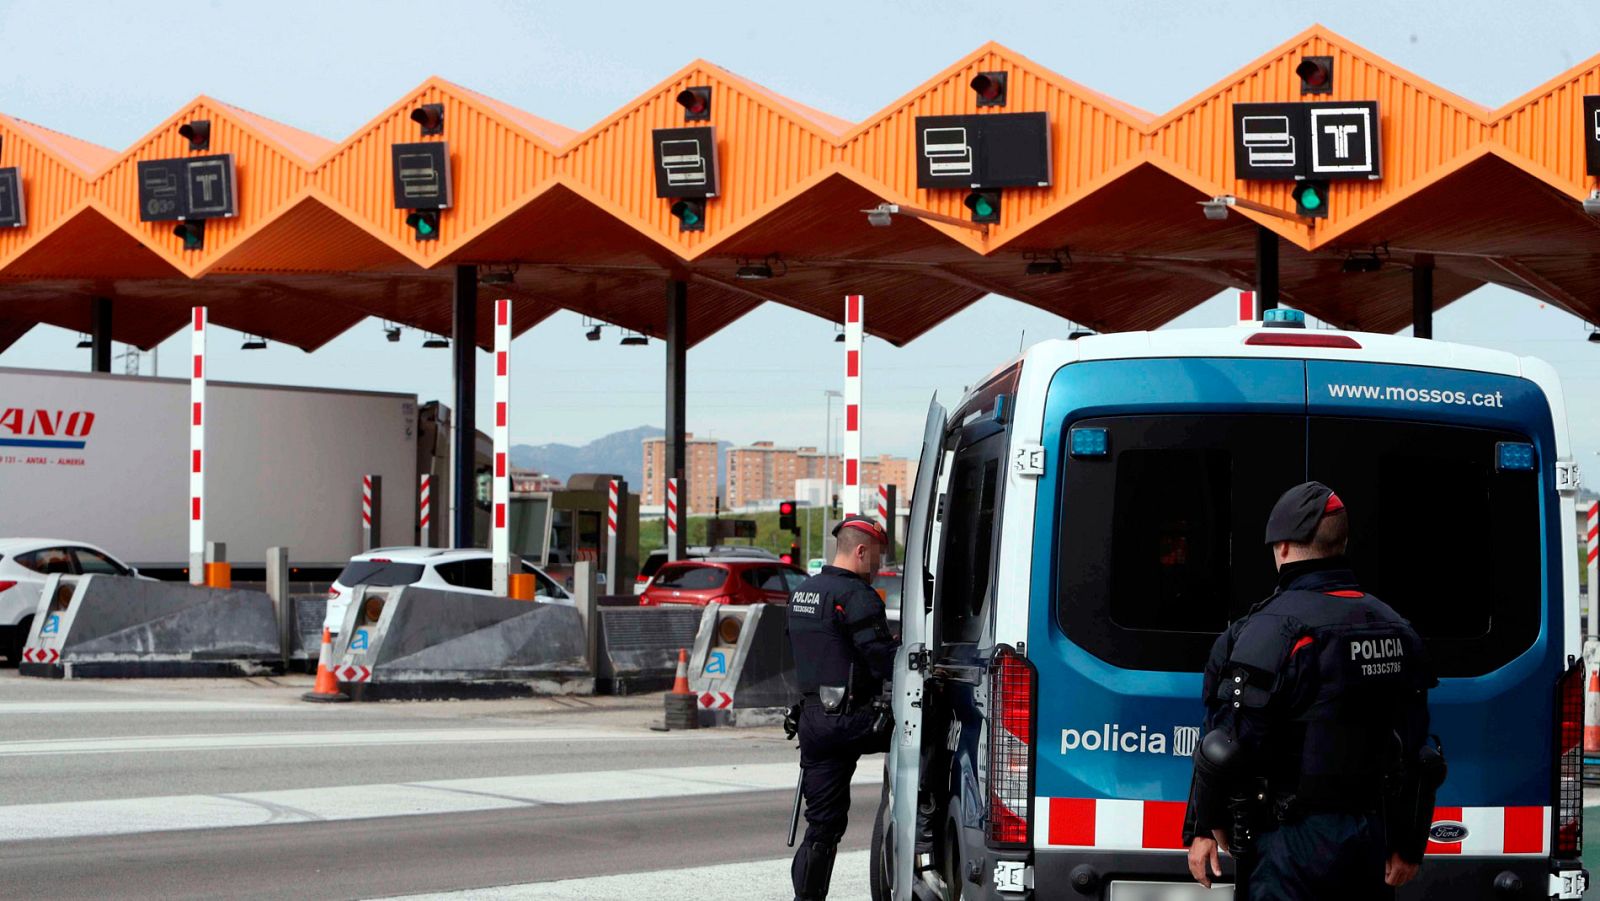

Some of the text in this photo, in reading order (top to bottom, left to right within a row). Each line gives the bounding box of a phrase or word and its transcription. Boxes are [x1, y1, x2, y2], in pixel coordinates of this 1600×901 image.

[1327, 383, 1503, 408] www.mossos.cat
[0, 408, 96, 437] ANO
[792, 591, 820, 605] POLICIA
[1350, 638, 1404, 660] POLICIA
[1060, 723, 1166, 755] policia
[1435, 826, 1460, 837] Ford
